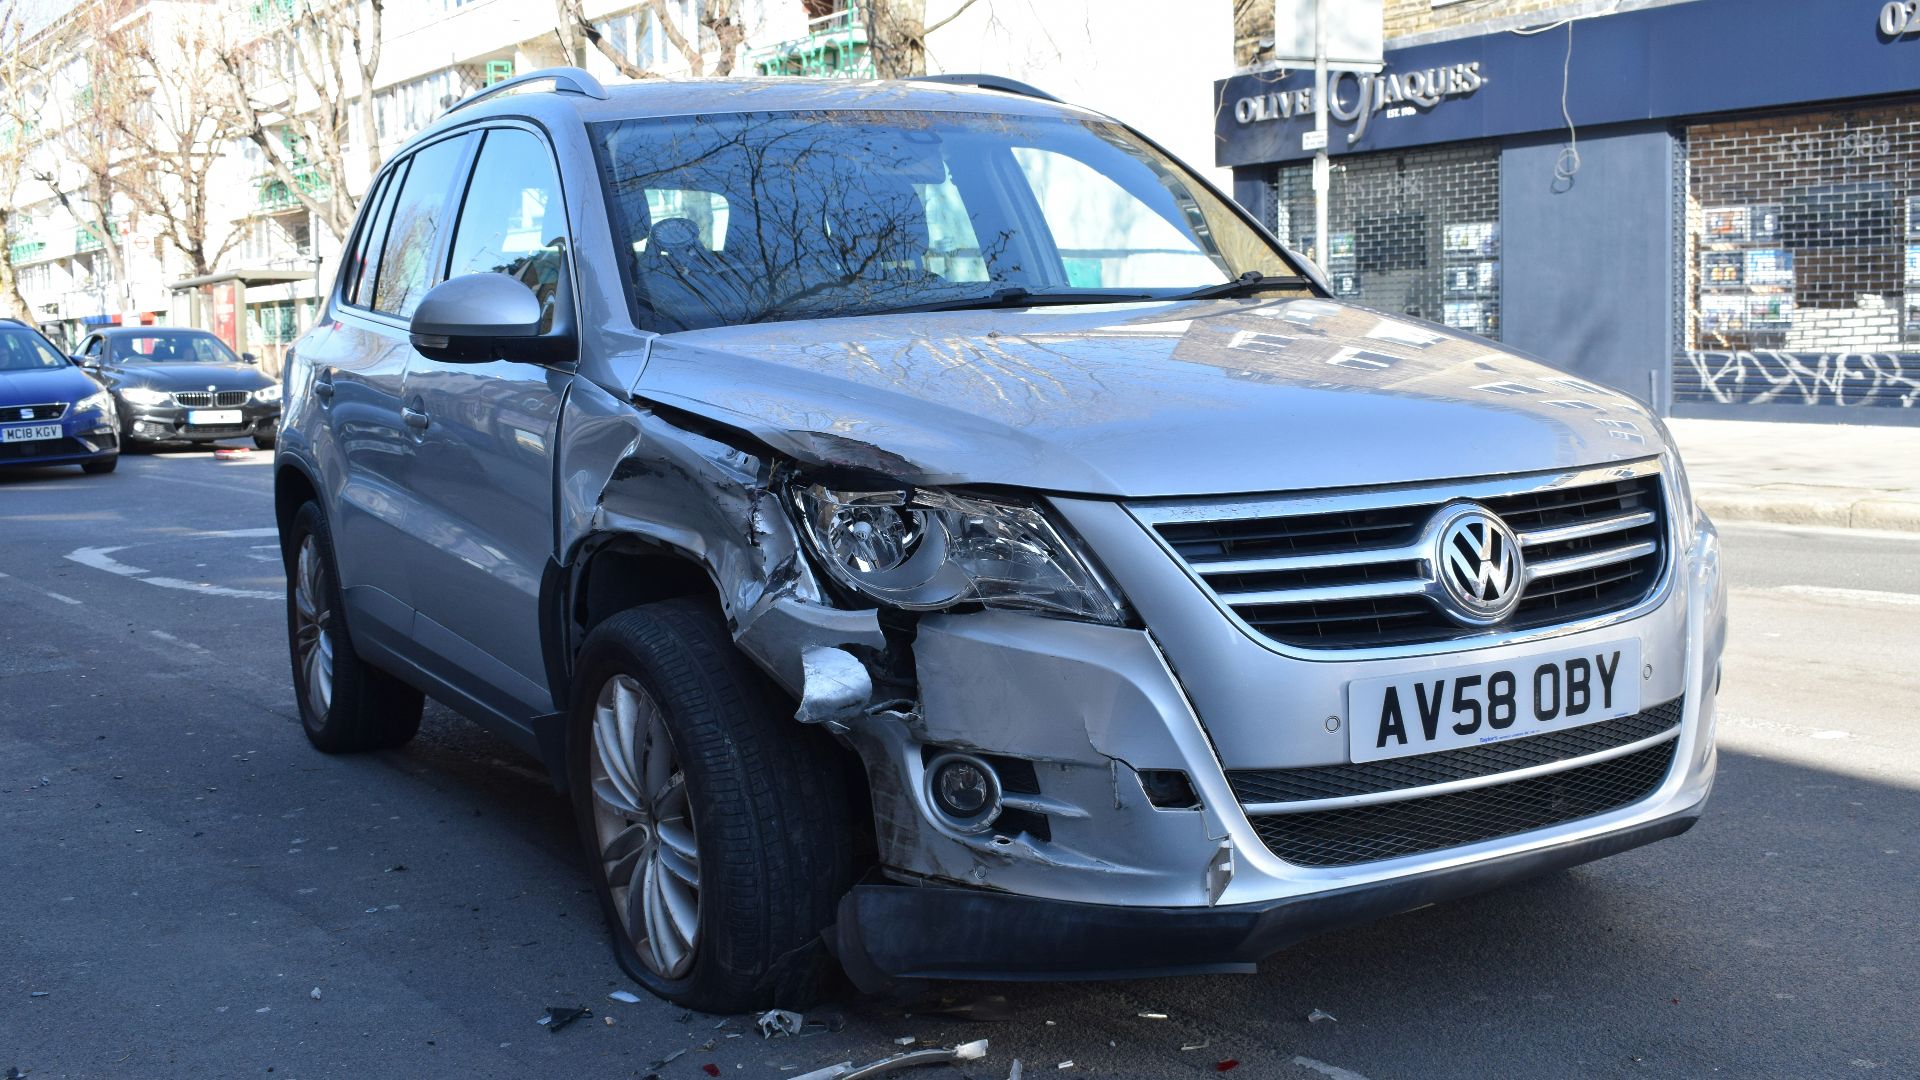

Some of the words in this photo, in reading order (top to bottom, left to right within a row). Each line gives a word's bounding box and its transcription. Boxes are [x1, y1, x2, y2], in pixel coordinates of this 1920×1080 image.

[1235, 87, 1318, 124] OLIVE
[1372, 61, 1481, 112] JAQUES
[7, 428, 33, 440] MC18
[36, 426, 57, 438] KGV
[1376, 670, 1517, 748] AV58
[1533, 651, 1621, 722] OBY
